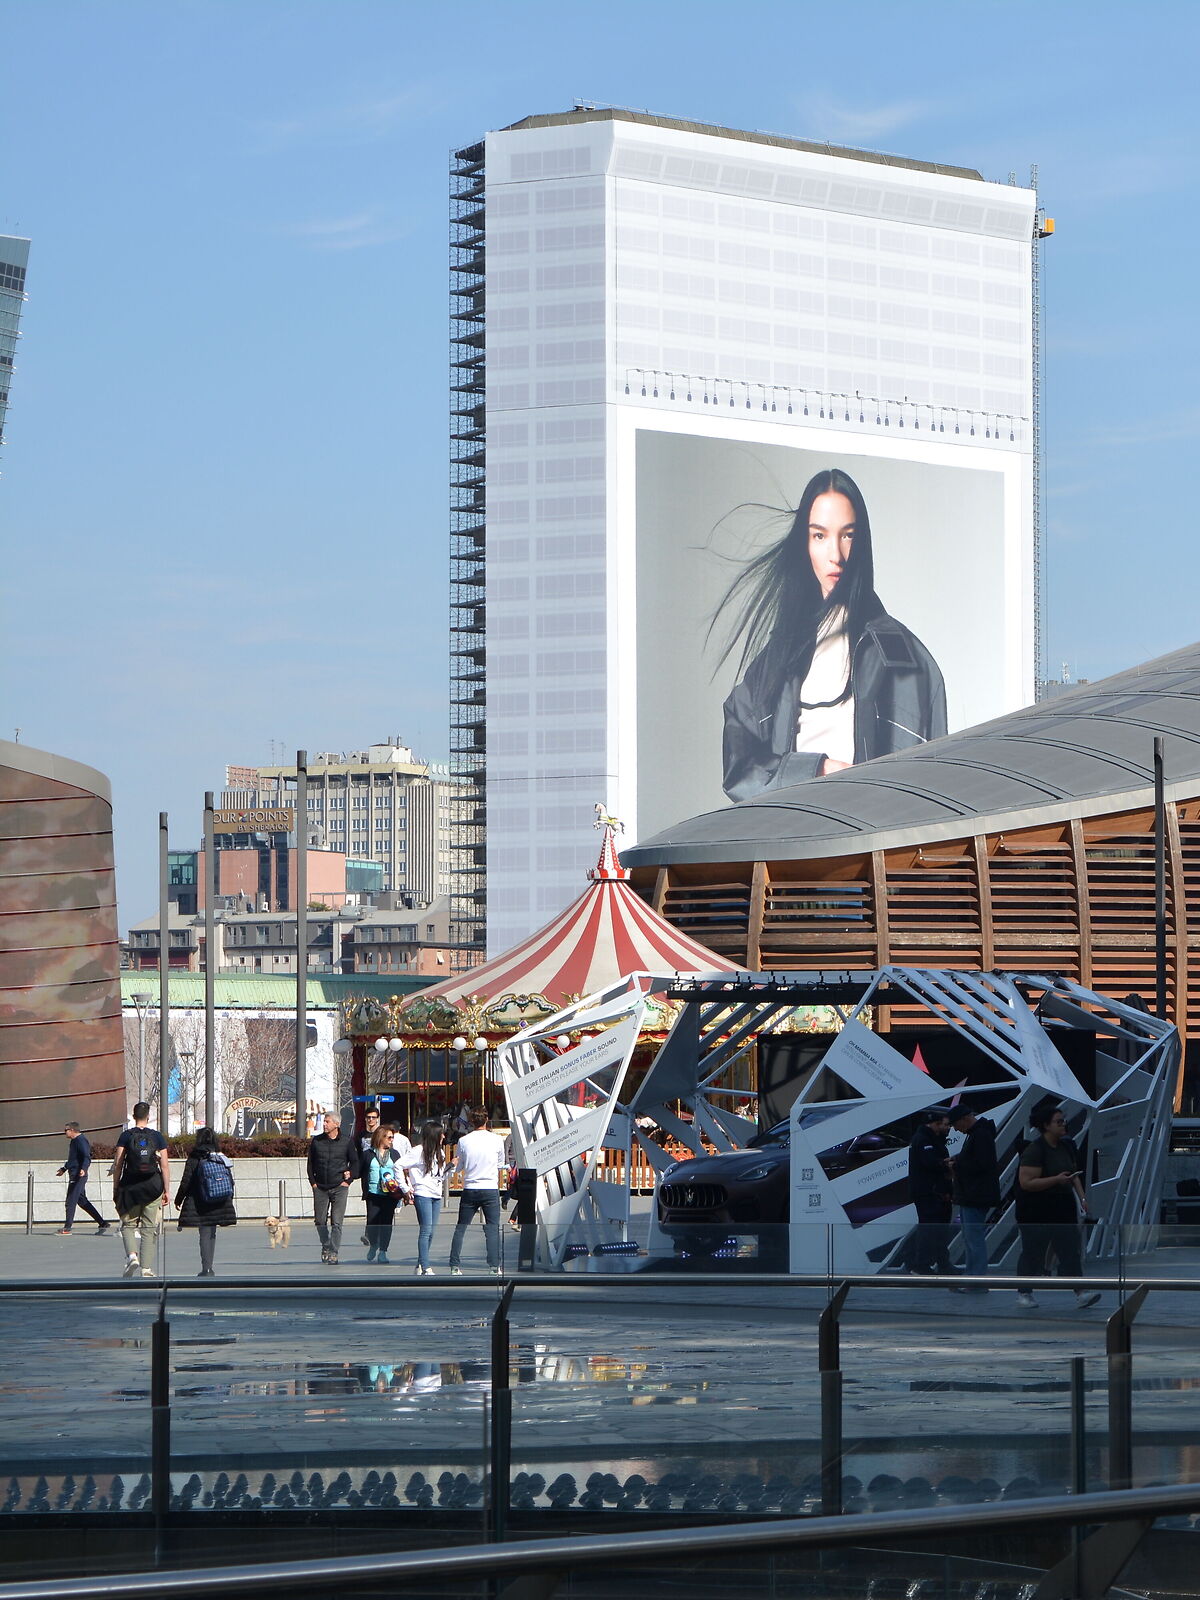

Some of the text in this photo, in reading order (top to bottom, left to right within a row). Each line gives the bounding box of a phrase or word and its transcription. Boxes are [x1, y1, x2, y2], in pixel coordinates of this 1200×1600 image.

[213, 810, 289, 823] OUR POINTS
[524, 1081, 539, 1091] PURE
[538, 1069, 560, 1085] ITALIAN
[560, 1058, 580, 1072] SONUS
[580, 1048, 597, 1061] FABER
[551, 1076, 560, 1085] TO
[560, 1065, 580, 1079] PLEASE
[231, 1098, 259, 1110] ENTRAT
[570, 1129, 579, 1137] YOU
[857, 1168, 887, 1185] POWERED
[895, 1160, 908, 1170] 530
